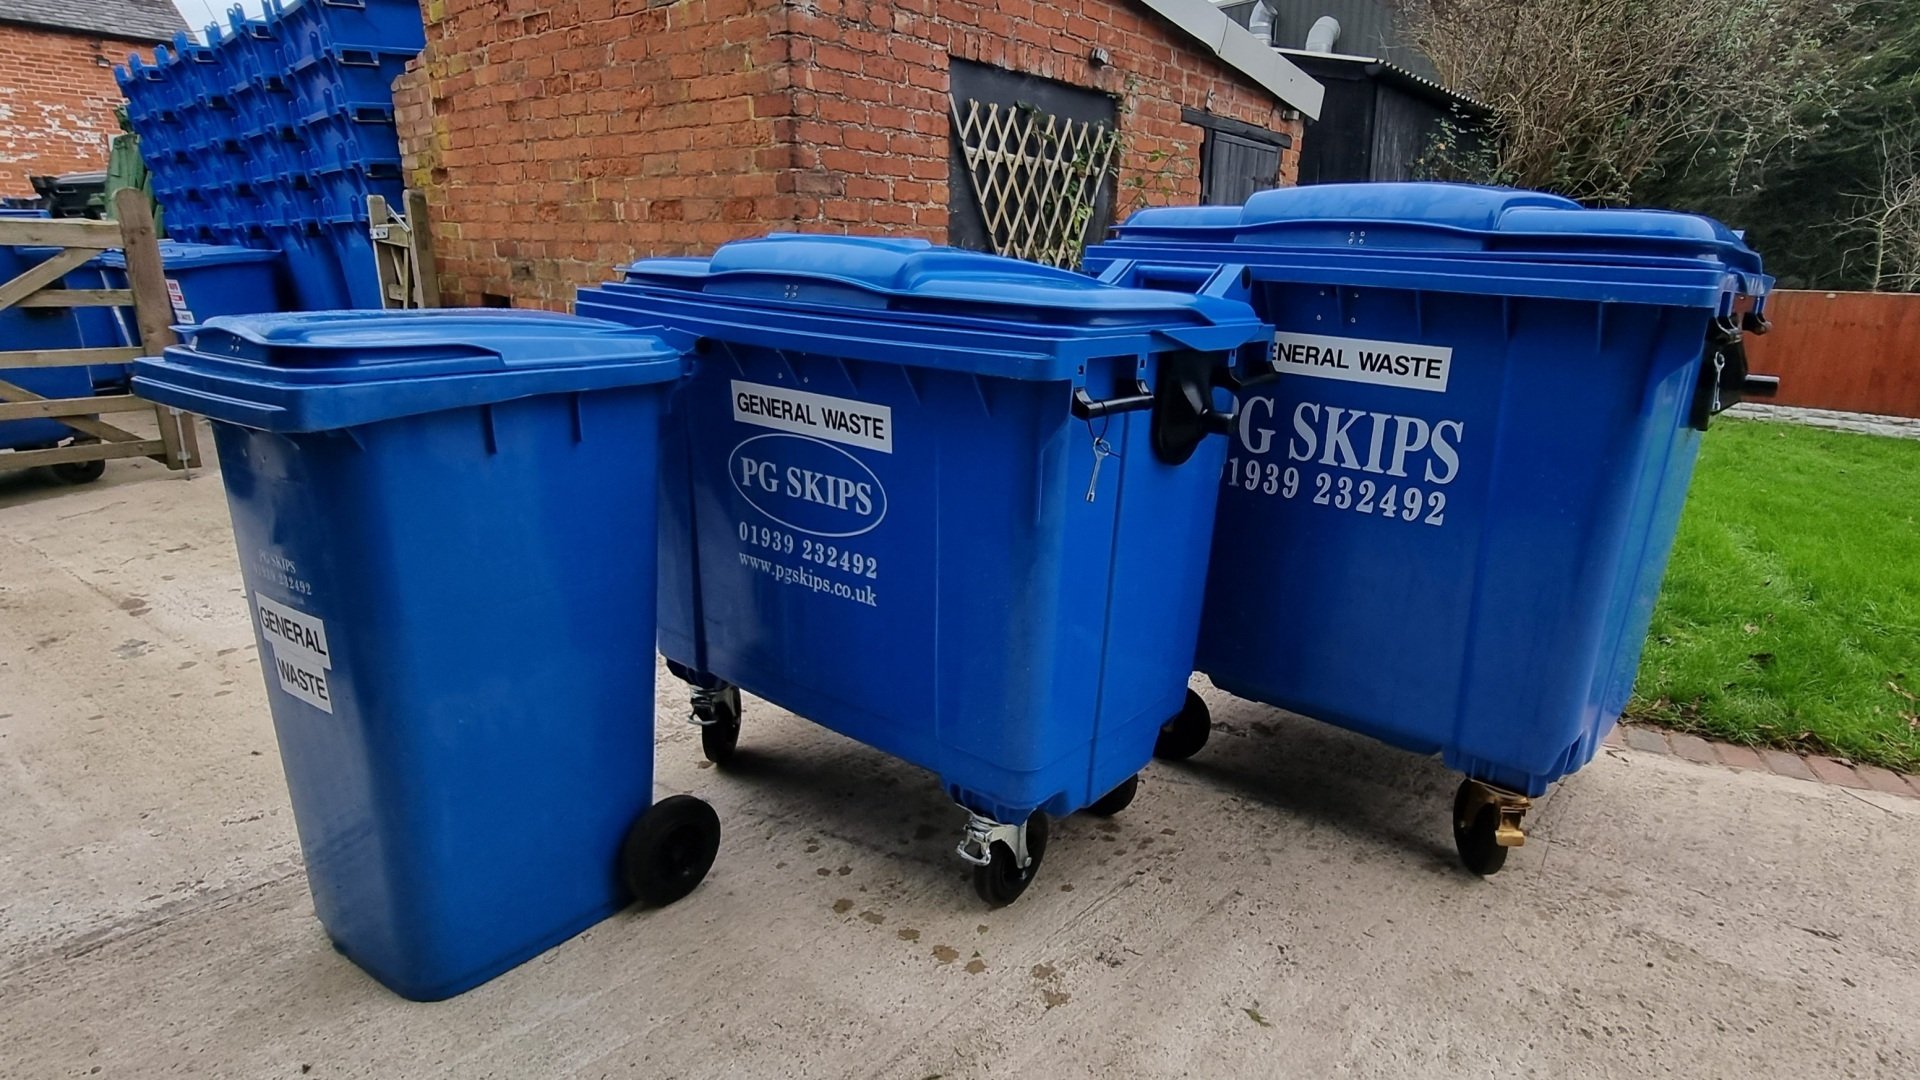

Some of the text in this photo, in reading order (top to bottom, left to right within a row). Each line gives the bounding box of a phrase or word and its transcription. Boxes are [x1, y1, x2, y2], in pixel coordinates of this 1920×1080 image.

[1272, 343, 1442, 379] NERAL WASTE
[737, 393, 884, 439] GENERAL WASTE
[1233, 395, 1464, 484] G SKIPS
[740, 456, 872, 515] PG SKIPS
[1220, 457, 1446, 526] 1939 232492
[739, 521, 877, 579] 01939 232492
[739, 552, 877, 607] www.pgskips.co.uk
[260, 606, 326, 656] GENERAL
[277, 657, 328, 701] WASTE
